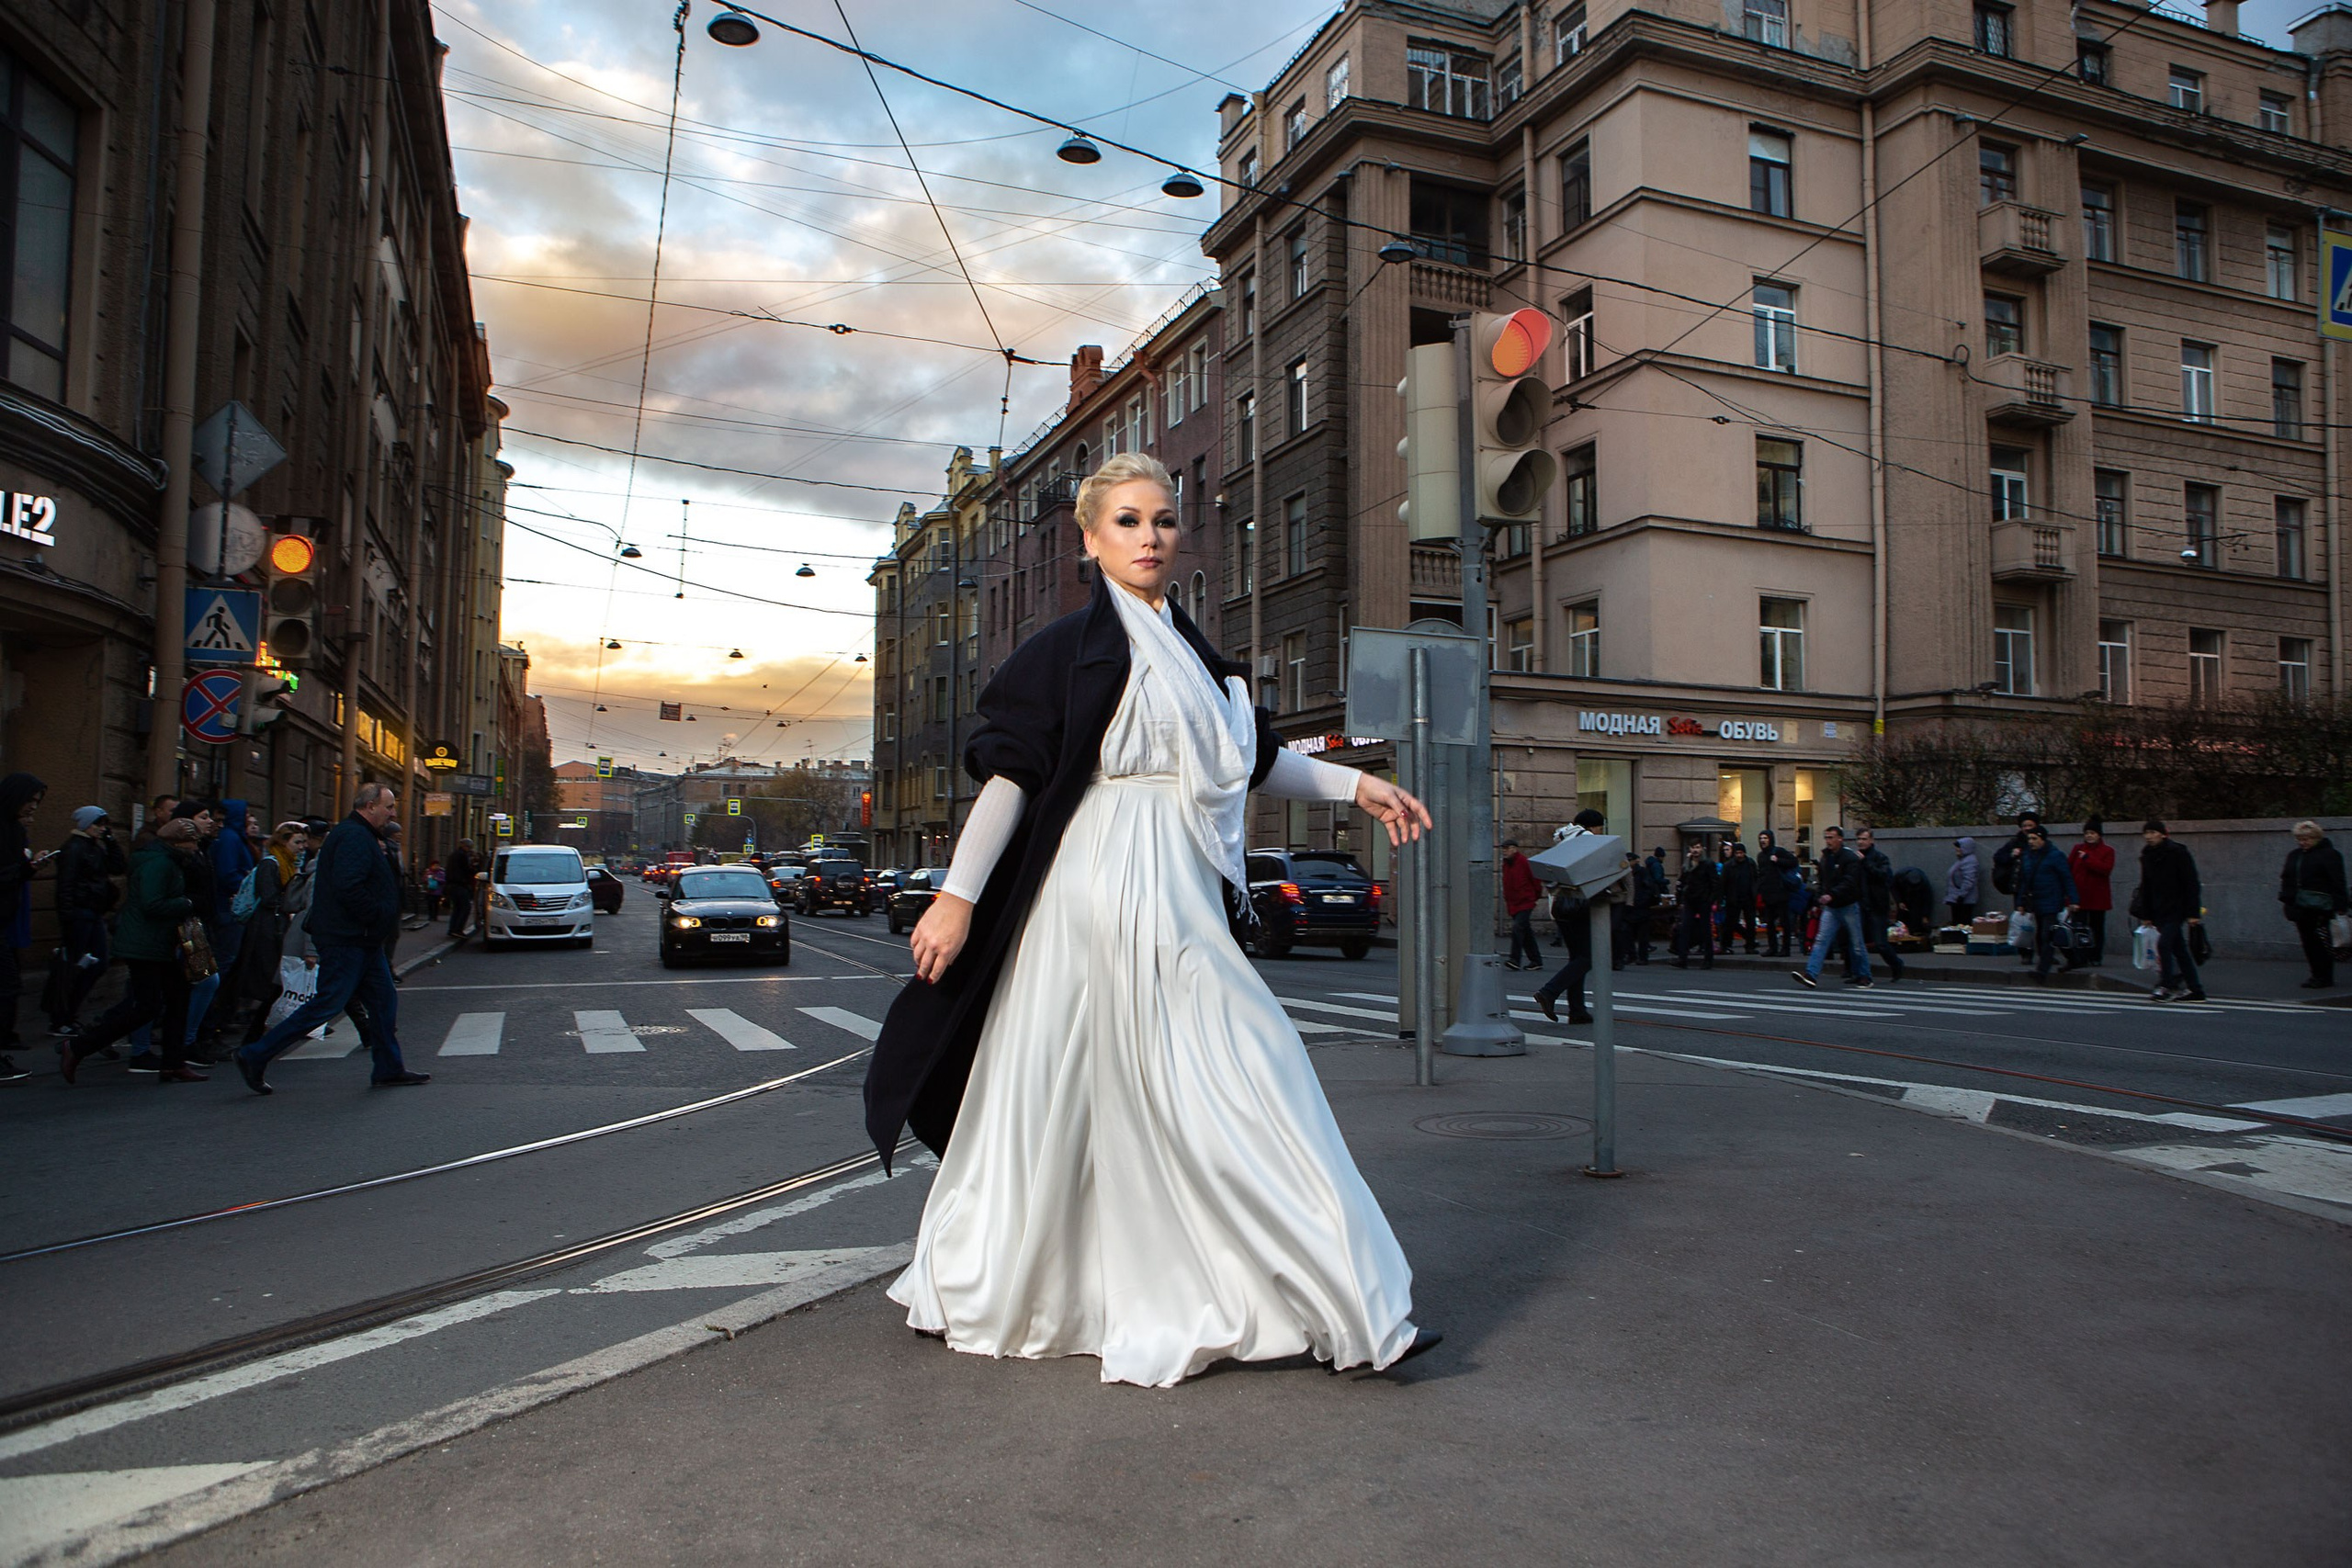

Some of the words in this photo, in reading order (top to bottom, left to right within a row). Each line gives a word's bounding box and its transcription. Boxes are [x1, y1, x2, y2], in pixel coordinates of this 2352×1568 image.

[1579, 711, 1661, 736] МОДНАЯ
[1667, 716, 1702, 735] Sofia
[1720, 720, 1779, 741] ОБУВЬ
